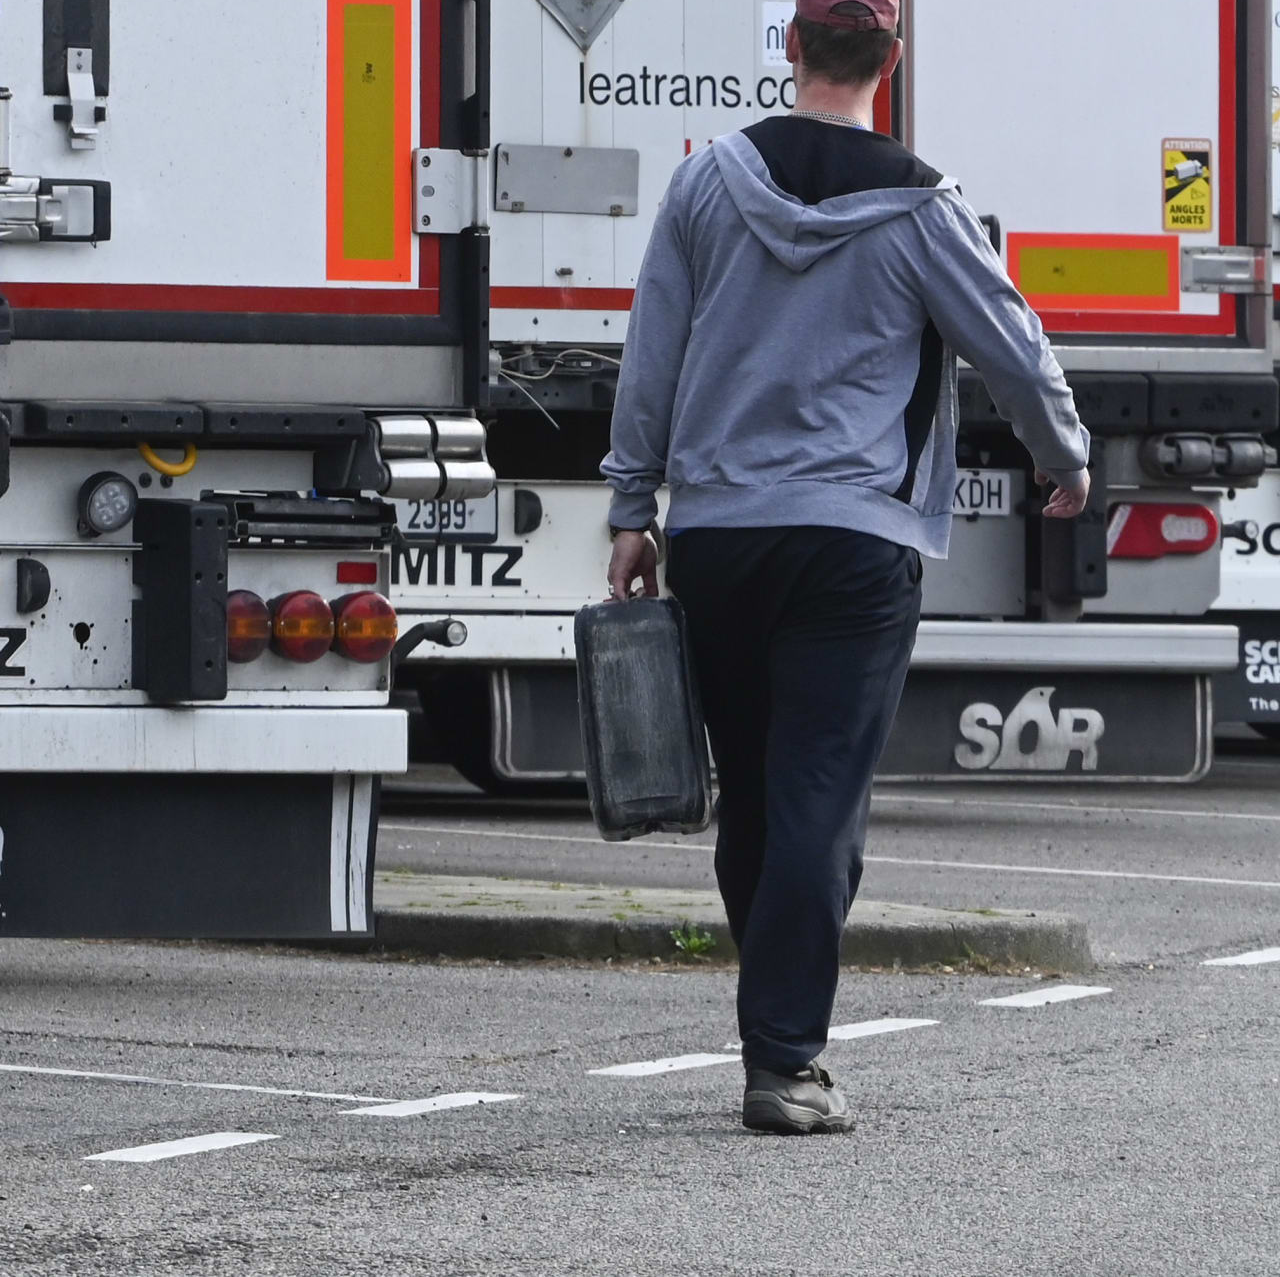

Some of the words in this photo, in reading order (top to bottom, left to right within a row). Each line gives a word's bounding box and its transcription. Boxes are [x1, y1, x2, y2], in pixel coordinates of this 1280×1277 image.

[1169, 204, 1206, 215] ANGLES
[1171, 215, 1204, 225] MORTS
[391, 545, 523, 587] MITZ
[1249, 697, 1280, 711] The
